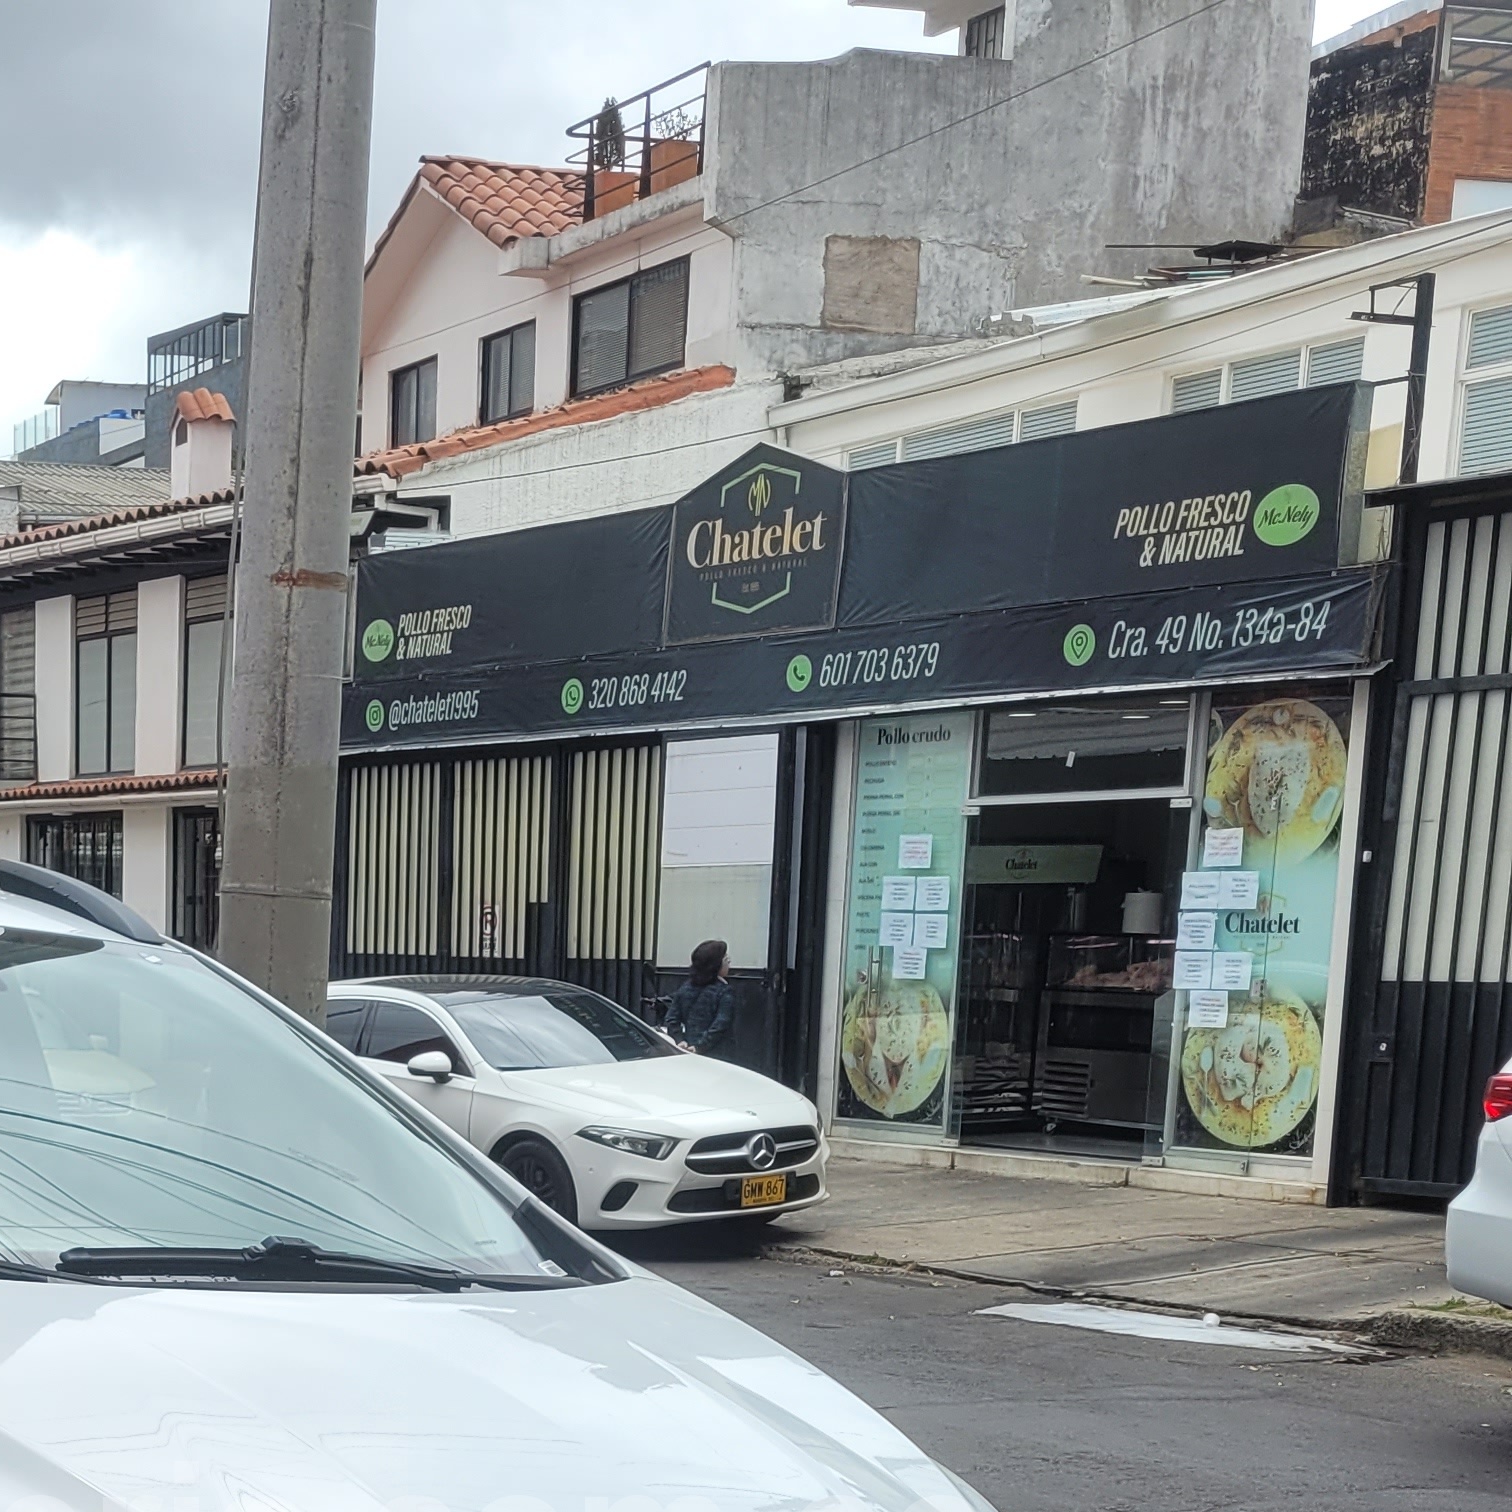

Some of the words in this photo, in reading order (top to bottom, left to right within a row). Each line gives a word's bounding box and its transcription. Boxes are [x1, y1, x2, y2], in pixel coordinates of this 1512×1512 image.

[1114, 501, 1175, 539] POLLO
[1175, 490, 1252, 531] FRESCO
[687, 506, 827, 569] Chatelet
[1139, 536, 1156, 567] &
[1158, 524, 1246, 566] NATURAL
[397, 610, 430, 637] POLLO
[431, 604, 472, 632] FRESCO
[1108, 620, 1149, 659] Cra.
[1155, 615, 1187, 655] 49
[1188, 611, 1223, 652] No.
[1231, 601, 1331, 648] 134a-84
[396, 637, 406, 660] &
[406, 631, 453, 659] NATURAL
[819, 653, 852, 687] 601
[852, 648, 889, 684] 703
[890, 642, 939, 680] 6379
[588, 677, 618, 709] 320
[619, 673, 649, 706] 868
[651, 669, 687, 703] 4142
[388, 689, 480, 731] @chatelet1995
[877, 727, 910, 745] Pollo
[912, 724, 951, 743] crudo
[1224, 912, 1300, 934] Chatelet
[766, 1178, 784, 1196] 867
